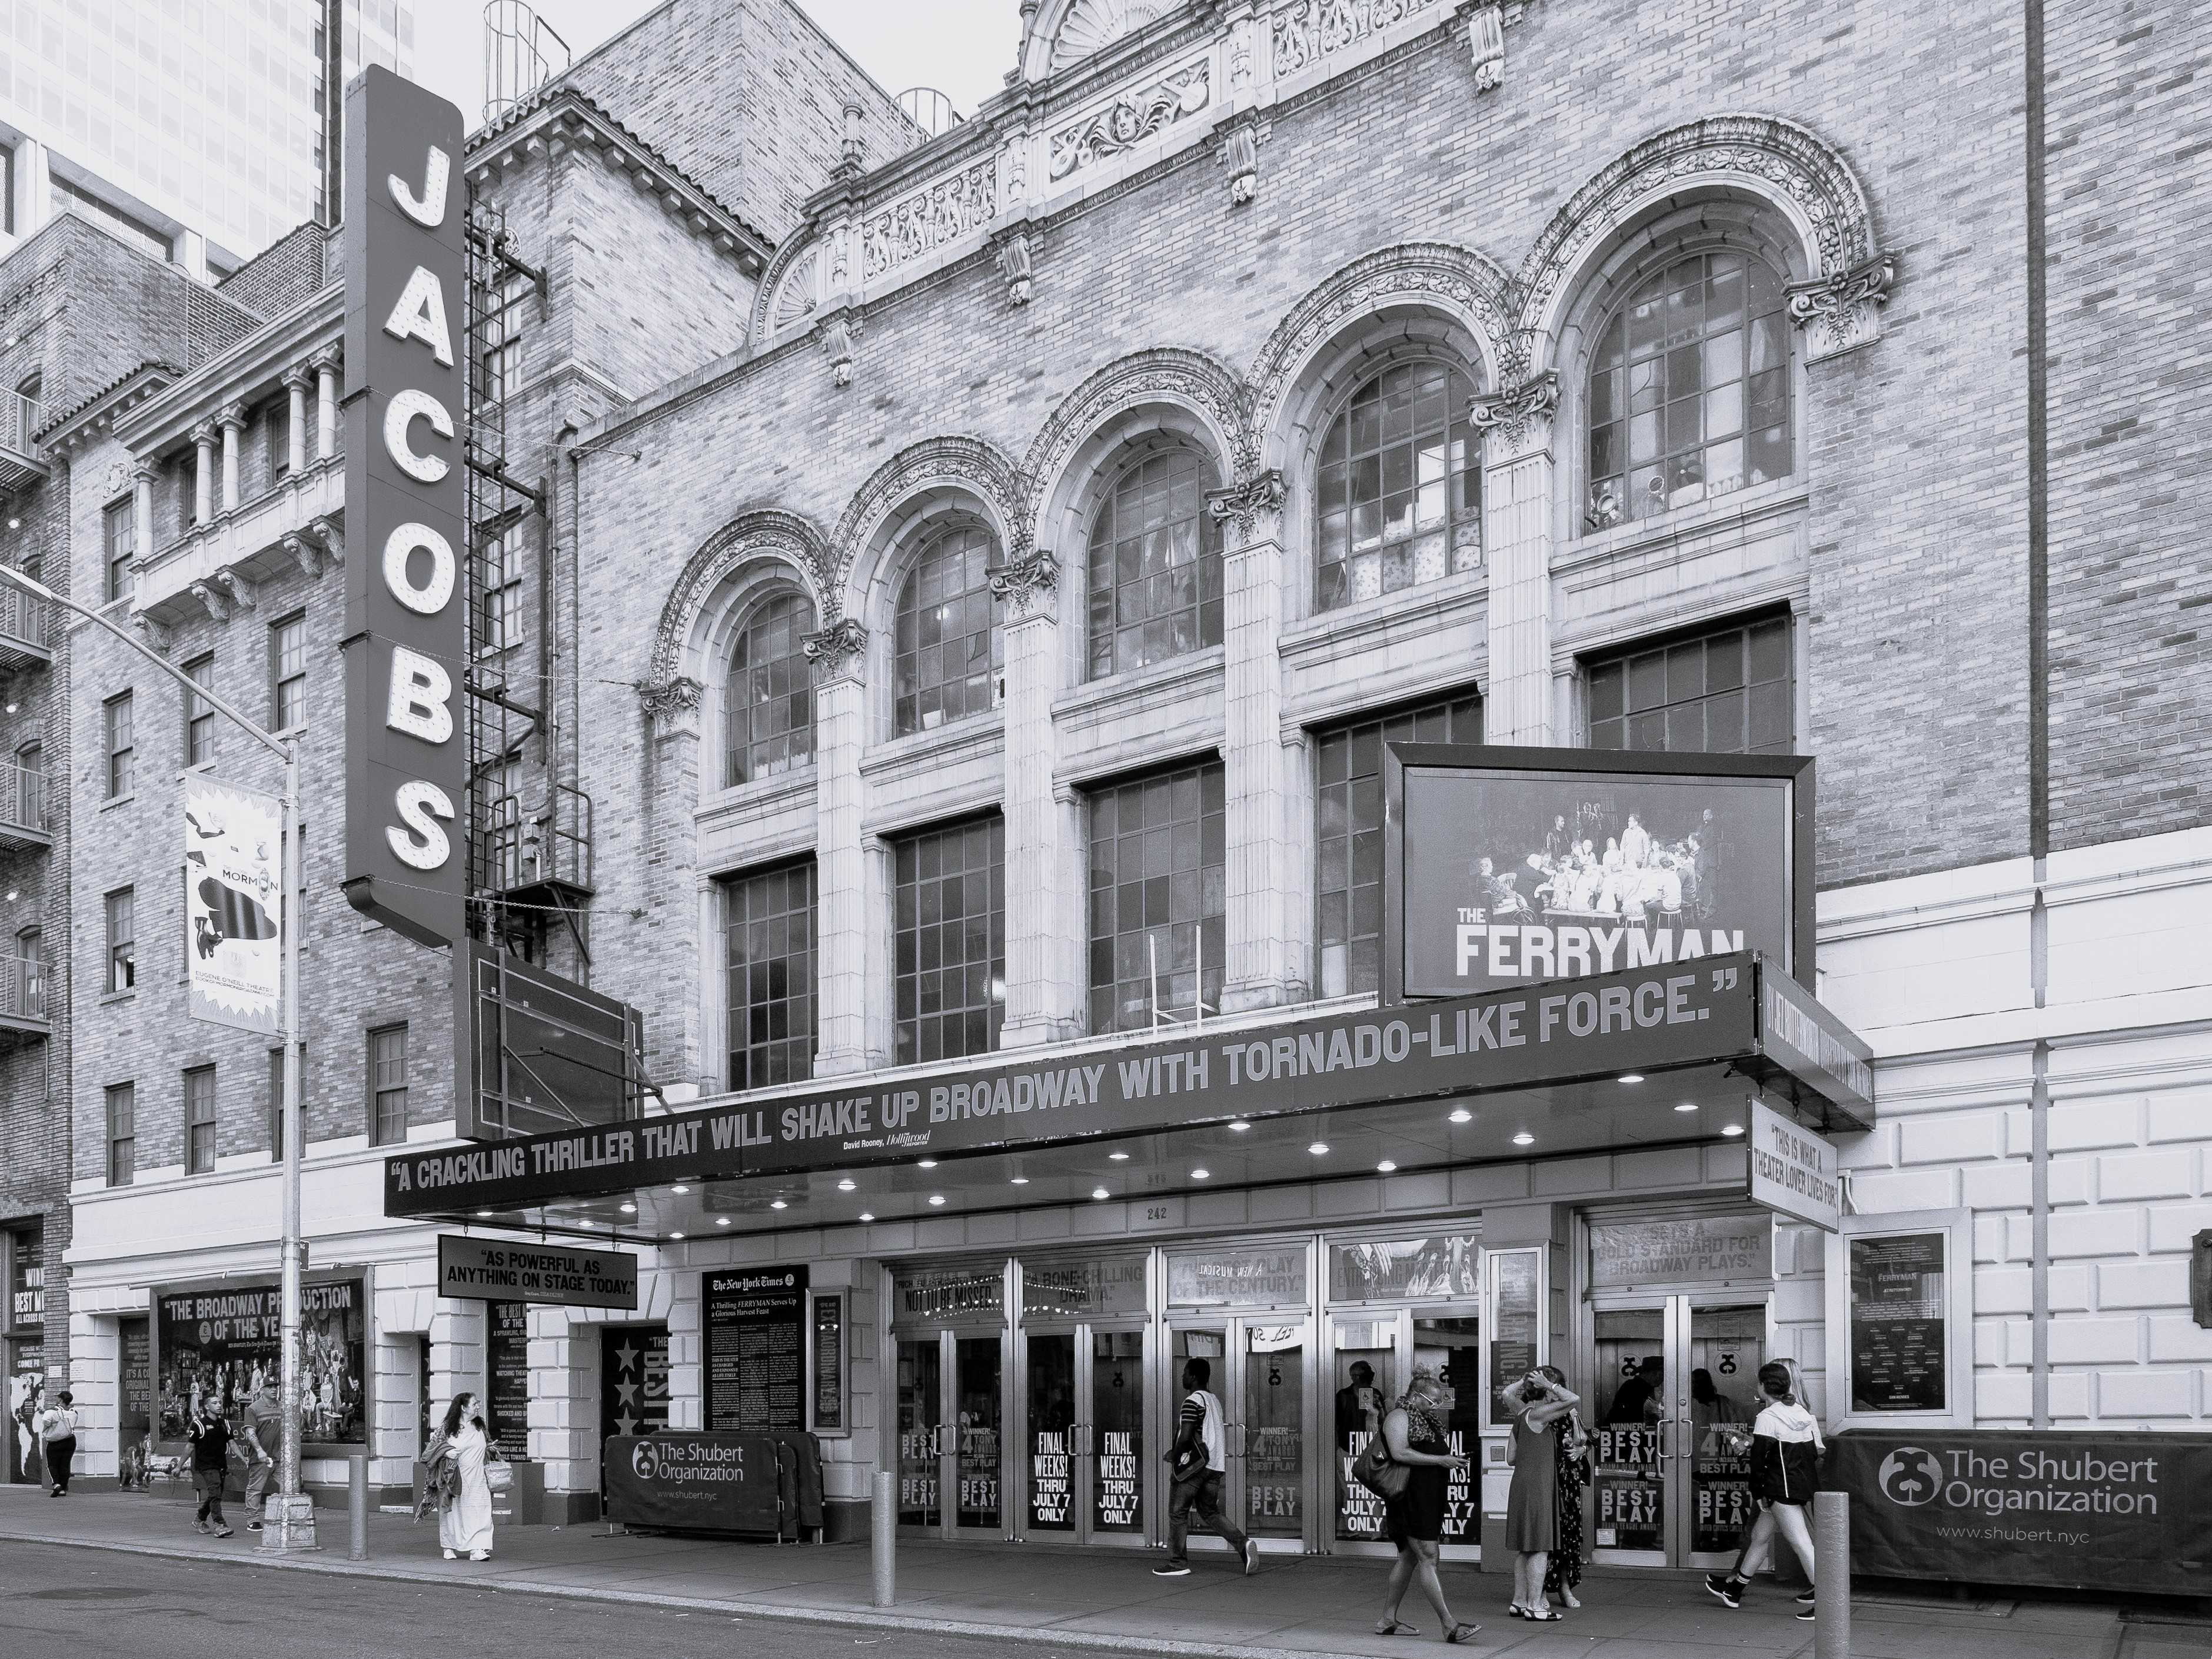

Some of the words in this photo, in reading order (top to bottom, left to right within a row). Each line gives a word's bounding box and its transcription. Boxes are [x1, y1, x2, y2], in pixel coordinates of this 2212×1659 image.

[383, 145, 455, 874] JACOBS
[1457, 907, 1486, 924] THE
[391, 1161, 412, 1193] “A
[417, 1146, 525, 1189] CRACKLING
[531, 1131, 635, 1175] THRILLER
[642, 1120, 703, 1159] THAT
[710, 1111, 772, 1151] WILL
[781, 1096, 872, 1142] SHAKE
[882, 1090, 920, 1129] UP
[929, 1063, 1106, 1124] BROADWAY
[1118, 1049, 1209, 1100] WITH
[1222, 1002, 1527, 1086] TORNADO-LIKE
[843, 1140, 860, 1150] David
[861, 1139, 884, 1147] Rooney,
[886, 1129, 931, 1147] Hollywood
[1771, 1123, 1789, 1156] “THIS
[1791, 1135, 1798, 1161] IS
[1799, 1139, 1817, 1171] WHAT
[1817, 1150, 1822, 1174] A
[1754, 1147, 1784, 1186] THEATER
[1786, 1163, 1806, 1196] LOVER
[1807, 1173, 1823, 1202] LIVES
[1147, 1208, 1167, 1220] 242
[1728, 1235, 1761, 1251] FOR
[480, 1249, 504, 1267] “AS
[508, 1252, 580, 1274] POWERFUL
[583, 1259, 601, 1275] AS
[1609, 1255, 1693, 1276] BROADWAY
[447, 1265, 517, 1286] ANYTHING
[522, 1272, 540, 1288] ON
[545, 1274, 586, 1292] STAGE
[713, 1279, 726, 1291] The
[727, 1279, 742, 1290] New
[743, 1276, 760, 1291] York
[761, 1276, 783, 1287] Times
[1878, 1272, 1917, 1282] FERRYMAN
[15, 1291, 34, 1313] BEST
[164, 1299, 193, 1321] “THE
[196, 1293, 264, 1320] BROADWAY
[716, 1301, 737, 1310] Thrilling
[738, 1299, 771, 1308] FERRYMAN
[789, 1298, 797, 1306] Up
[905, 1289, 923, 1312] NOT
[927, 1289, 938, 1310] TO
[940, 1288, 952, 1309] BE
[508, 1304, 521, 1318] BEST
[214, 1320, 229, 1341] OF
[233, 1318, 260, 1339] THE
[503, 1319, 511, 1328] OF
[512, 1318, 524, 1328] THE
[138, 1369, 142, 1378] A
[129, 1391, 140, 1401] THE
[130, 1402, 138, 1412] OF
[138, 1402, 149, 1412] THE
[1260, 1427, 1289, 1435] WINNER!
[1609, 1422, 1646, 1431] WINNER!
[1709, 1422, 1748, 1432] WINNER!
[902, 1434, 934, 1447] BEST
[962, 1435, 973, 1454] 4
[974, 1435, 997, 1444] TONY
[1039, 1432, 1065, 1454] FINAL
[1105, 1432, 1132, 1455] FINAL
[1252, 1435, 1265, 1457] 4
[1268, 1435, 1295, 1445] TONY
[1600, 1431, 1656, 1447] BEST
[1700, 1432, 1719, 1456] 4
[659, 1442, 687, 1462] The
[688, 1443, 744, 1462] Shubert
[902, 1447, 935, 1459] PLAY
[974, 1444, 997, 1454] AWARDS
[1268, 1445, 1295, 1456] AWARDS
[1600, 1447, 1656, 1463] PLAY
[962, 1459, 979, 1467] BEST
[979, 1459, 997, 1467] PLAY
[1035, 1455, 1068, 1477] WEEKS!
[1100, 1455, 1136, 1478] WEEKS!
[1253, 1462, 1273, 1471] BEST
[1275, 1461, 1296, 1471] PLAY
[1699, 1463, 1728, 1474] BEST
[1945, 1449, 2009, 1479] The
[2017, 1451, 2158, 1484] Shubert
[659, 1462, 744, 1484] Organization
[902, 1479, 936, 1492] BEST
[962, 1480, 997, 1494] BEST
[1037, 1479, 1066, 1492] THRU
[1103, 1480, 1134, 1494] THRU
[1609, 1480, 1648, 1490] WINNER!
[1708, 1481, 1749, 1491] WINNER!
[657, 1490, 717, 1501] www.shubert.nyc
[902, 1491, 936, 1505] PLAY
[962, 1493, 997, 1507] PLAY
[1033, 1493, 1060, 1507] JULY
[1063, 1494, 1070, 1507] 7
[1252, 1486, 1296, 1501] BEST
[1601, 1489, 1657, 1507] BEST
[1945, 1480, 2158, 1517] Organization
[1099, 1495, 1127, 1509] JULY
[1131, 1495, 1139, 1510] 7
[1252, 1501, 1296, 1515] PLAY
[1342, 1500, 1376, 1515] JULY
[1464, 1502, 1475, 1518] 7
[1037, 1508, 1066, 1521] ONLY
[1103, 1510, 1133, 1524] ONLY
[1601, 1505, 1657, 1522] PLAY
[1348, 1517, 1383, 1532] ONLY
[1936, 1525, 2090, 1547] www.shubert.nyc
